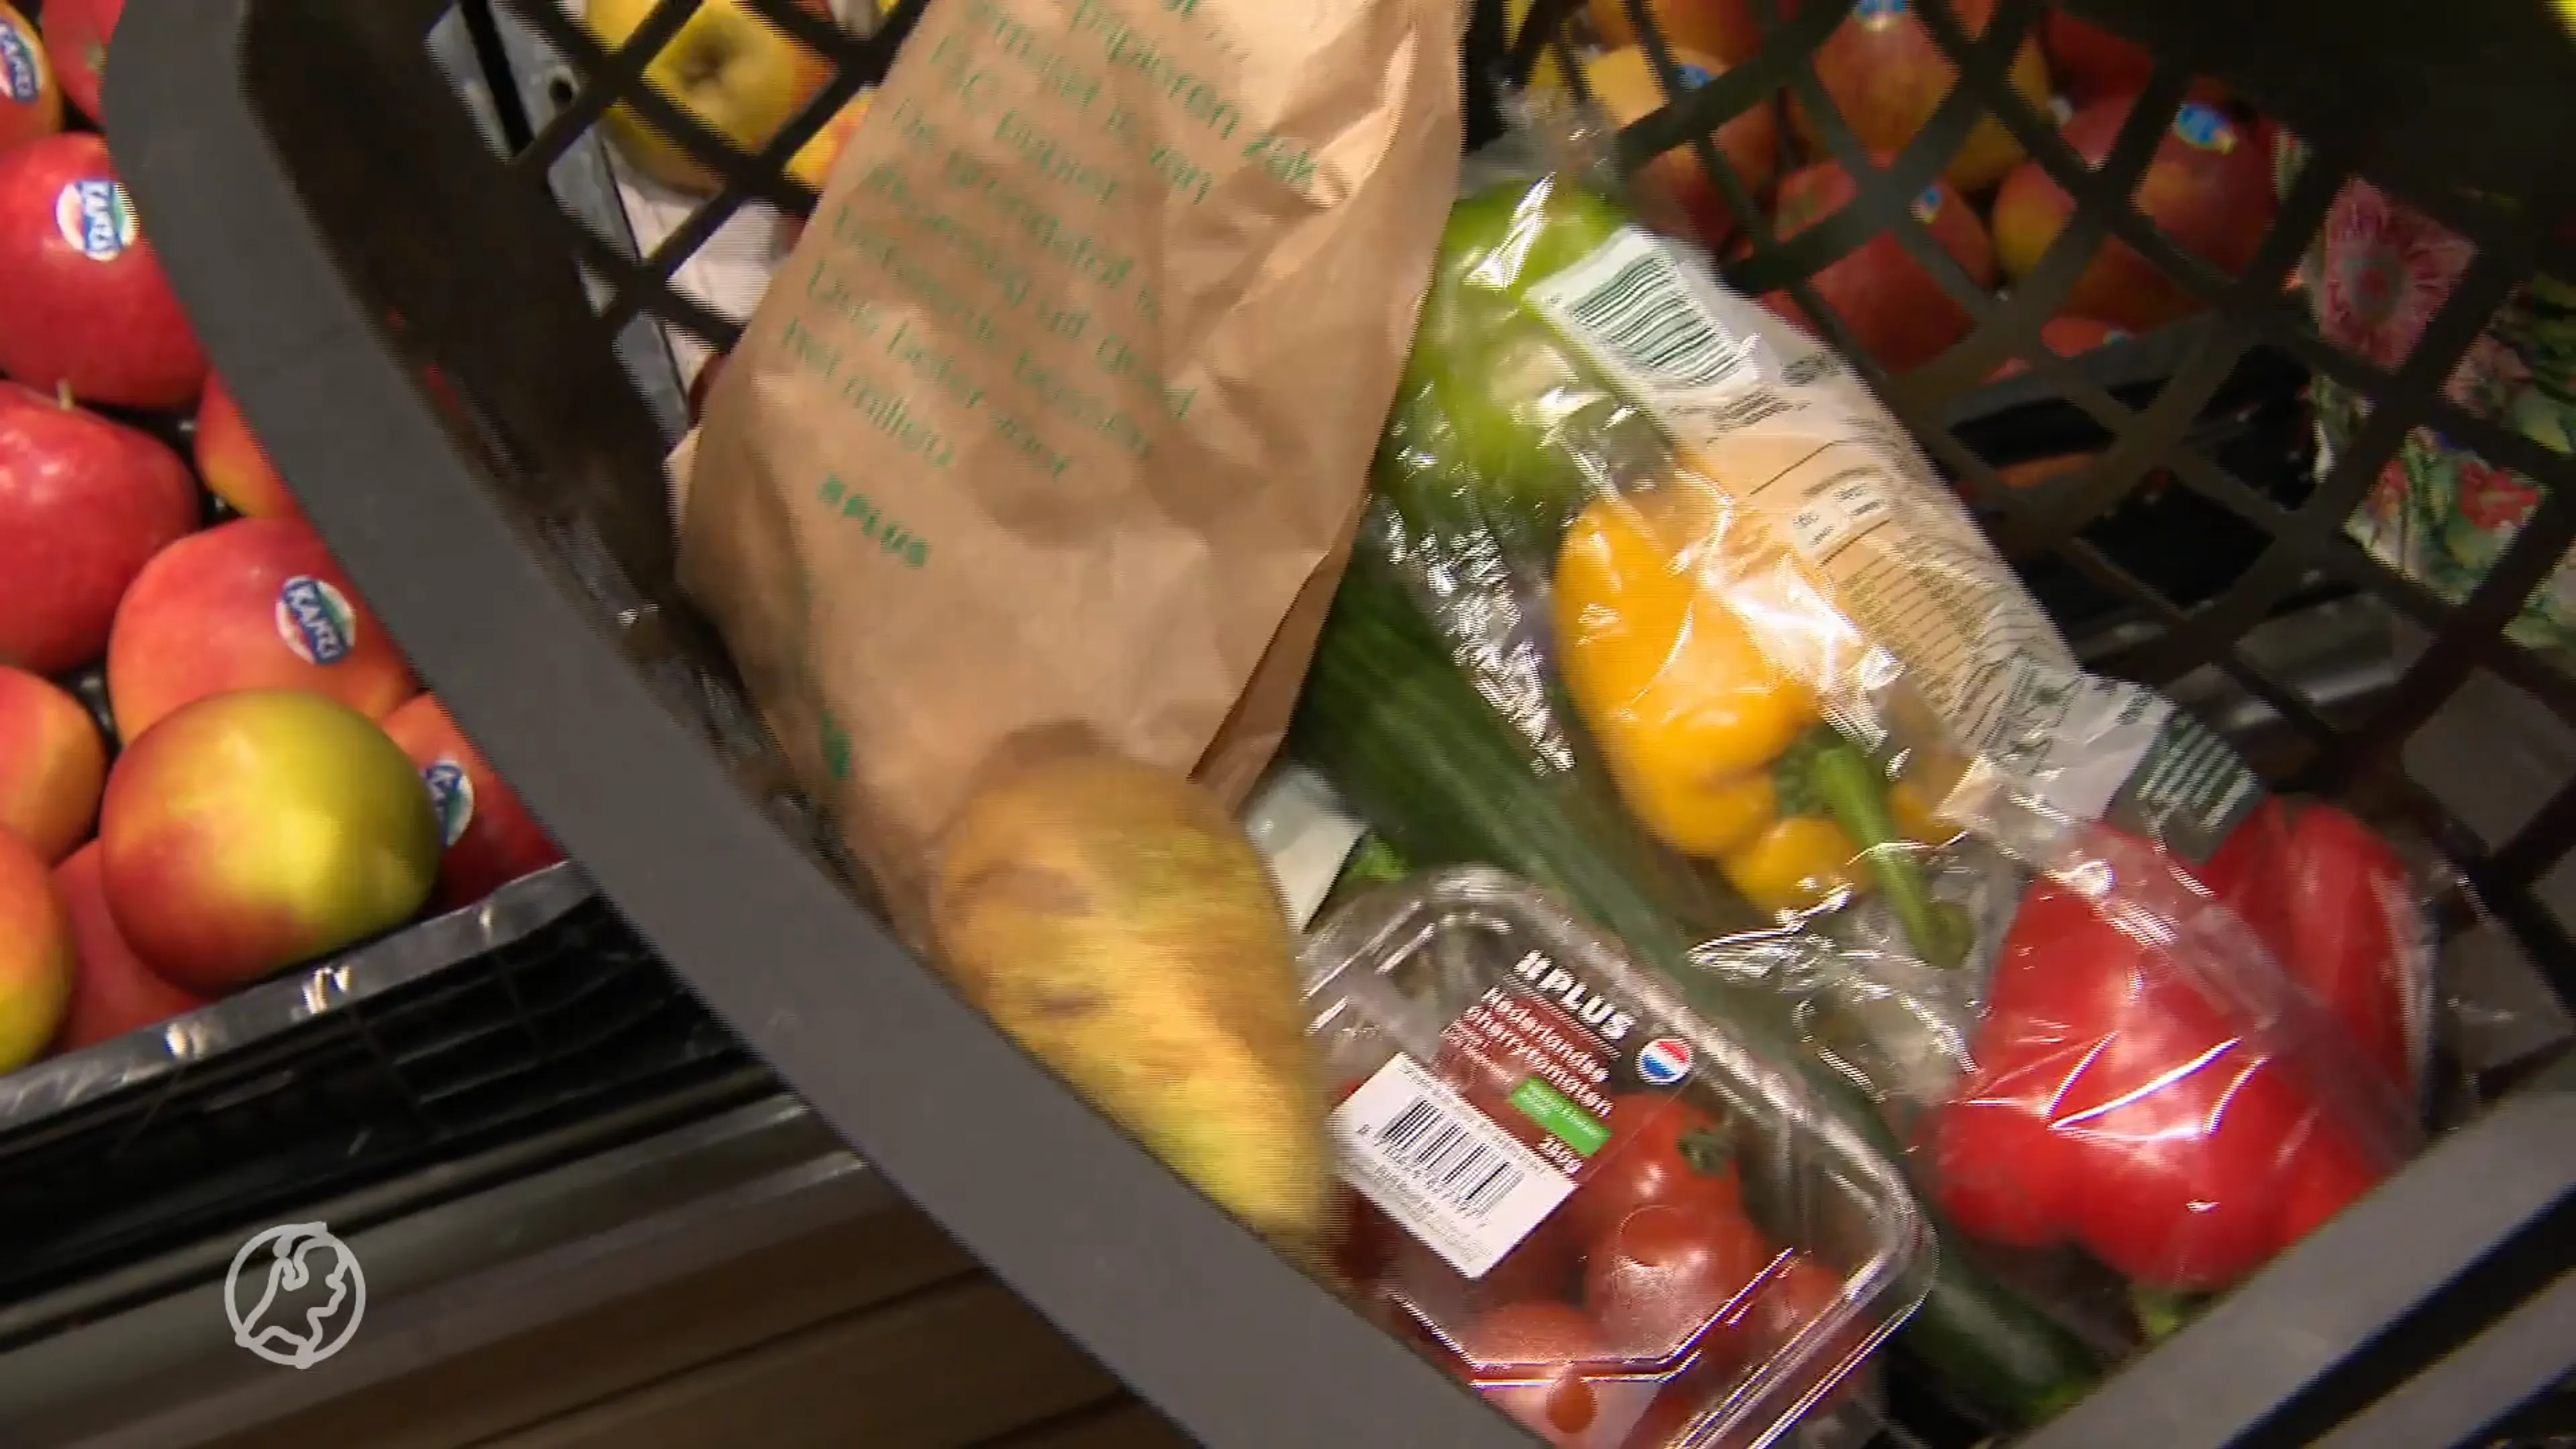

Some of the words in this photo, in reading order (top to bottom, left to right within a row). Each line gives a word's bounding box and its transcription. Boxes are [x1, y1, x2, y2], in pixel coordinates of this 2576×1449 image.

[1144, 140, 1218, 205] van
[1241, 122, 1323, 193] zak
[286, 585, 341, 660] KANZI
[1482, 983, 1611, 1083] Nederlandse
[1539, 965, 1638, 1040] PLUS
